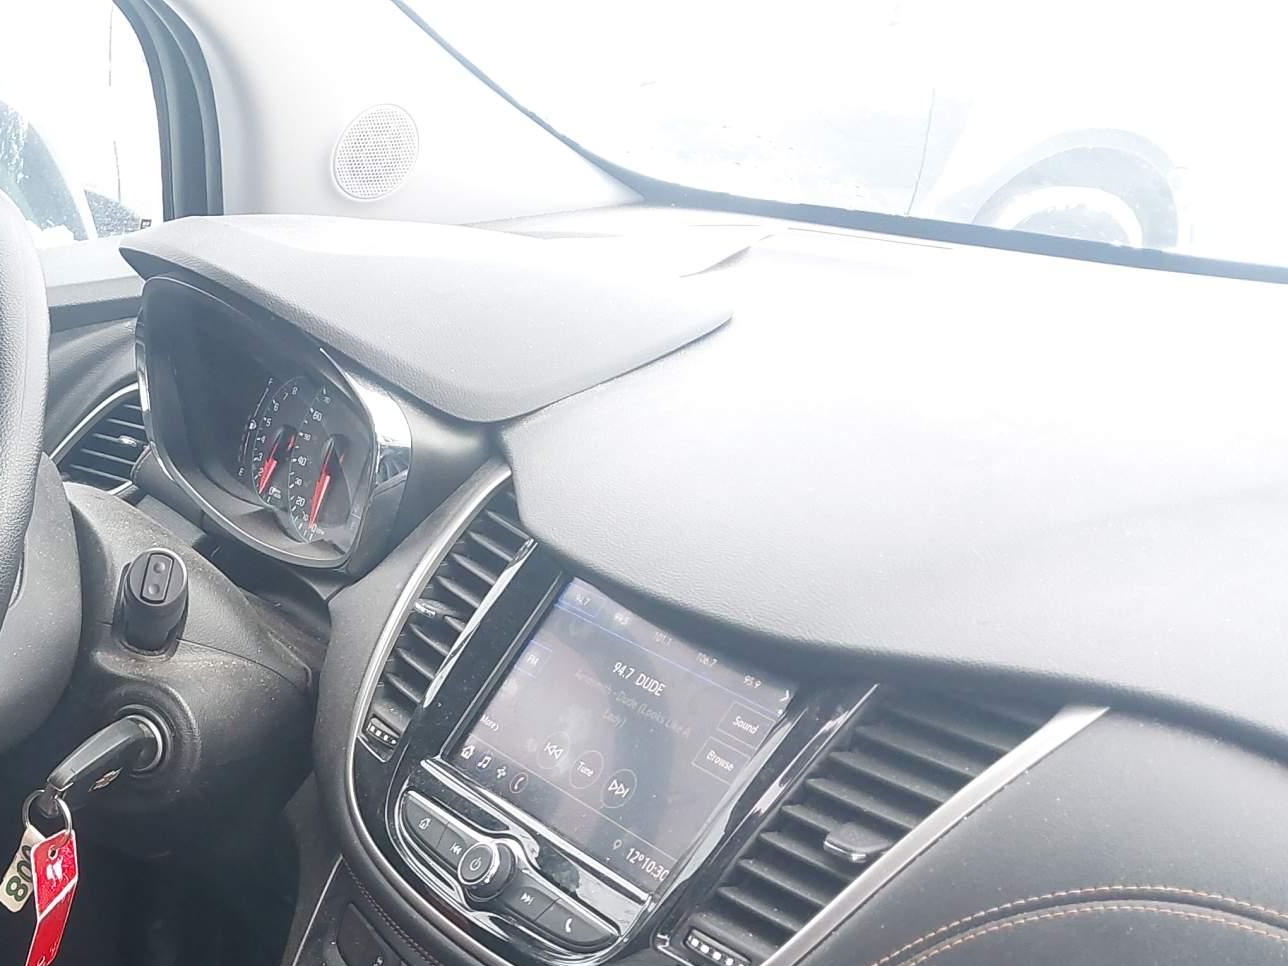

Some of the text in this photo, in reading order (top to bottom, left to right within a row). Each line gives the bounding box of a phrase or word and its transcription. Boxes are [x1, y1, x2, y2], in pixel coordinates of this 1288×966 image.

[274, 403, 279, 411] 6
[266, 418, 272, 427] 5
[296, 496, 306, 506] 20
[612, 661, 636, 681] 94.7
[635, 672, 668, 697] DUDE
[732, 715, 760, 736] Sound
[577, 761, 594, 777] Tune
[705, 750, 735, 772] Browse
